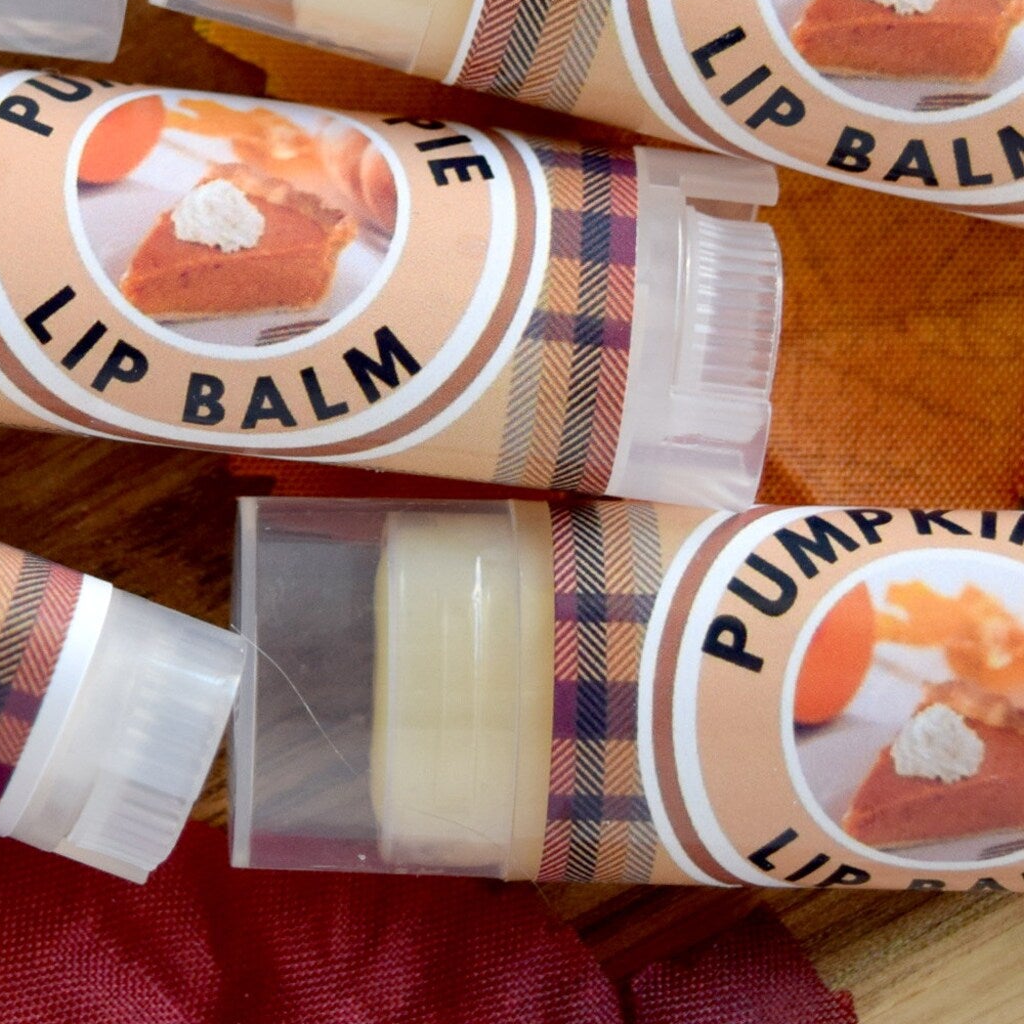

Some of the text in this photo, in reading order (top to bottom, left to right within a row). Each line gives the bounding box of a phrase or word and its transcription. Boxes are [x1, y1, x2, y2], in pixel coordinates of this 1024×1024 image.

[690, 26, 806, 130] LIP
[23, 285, 422, 430] LIP BALM
[747, 827, 871, 887] LIP
